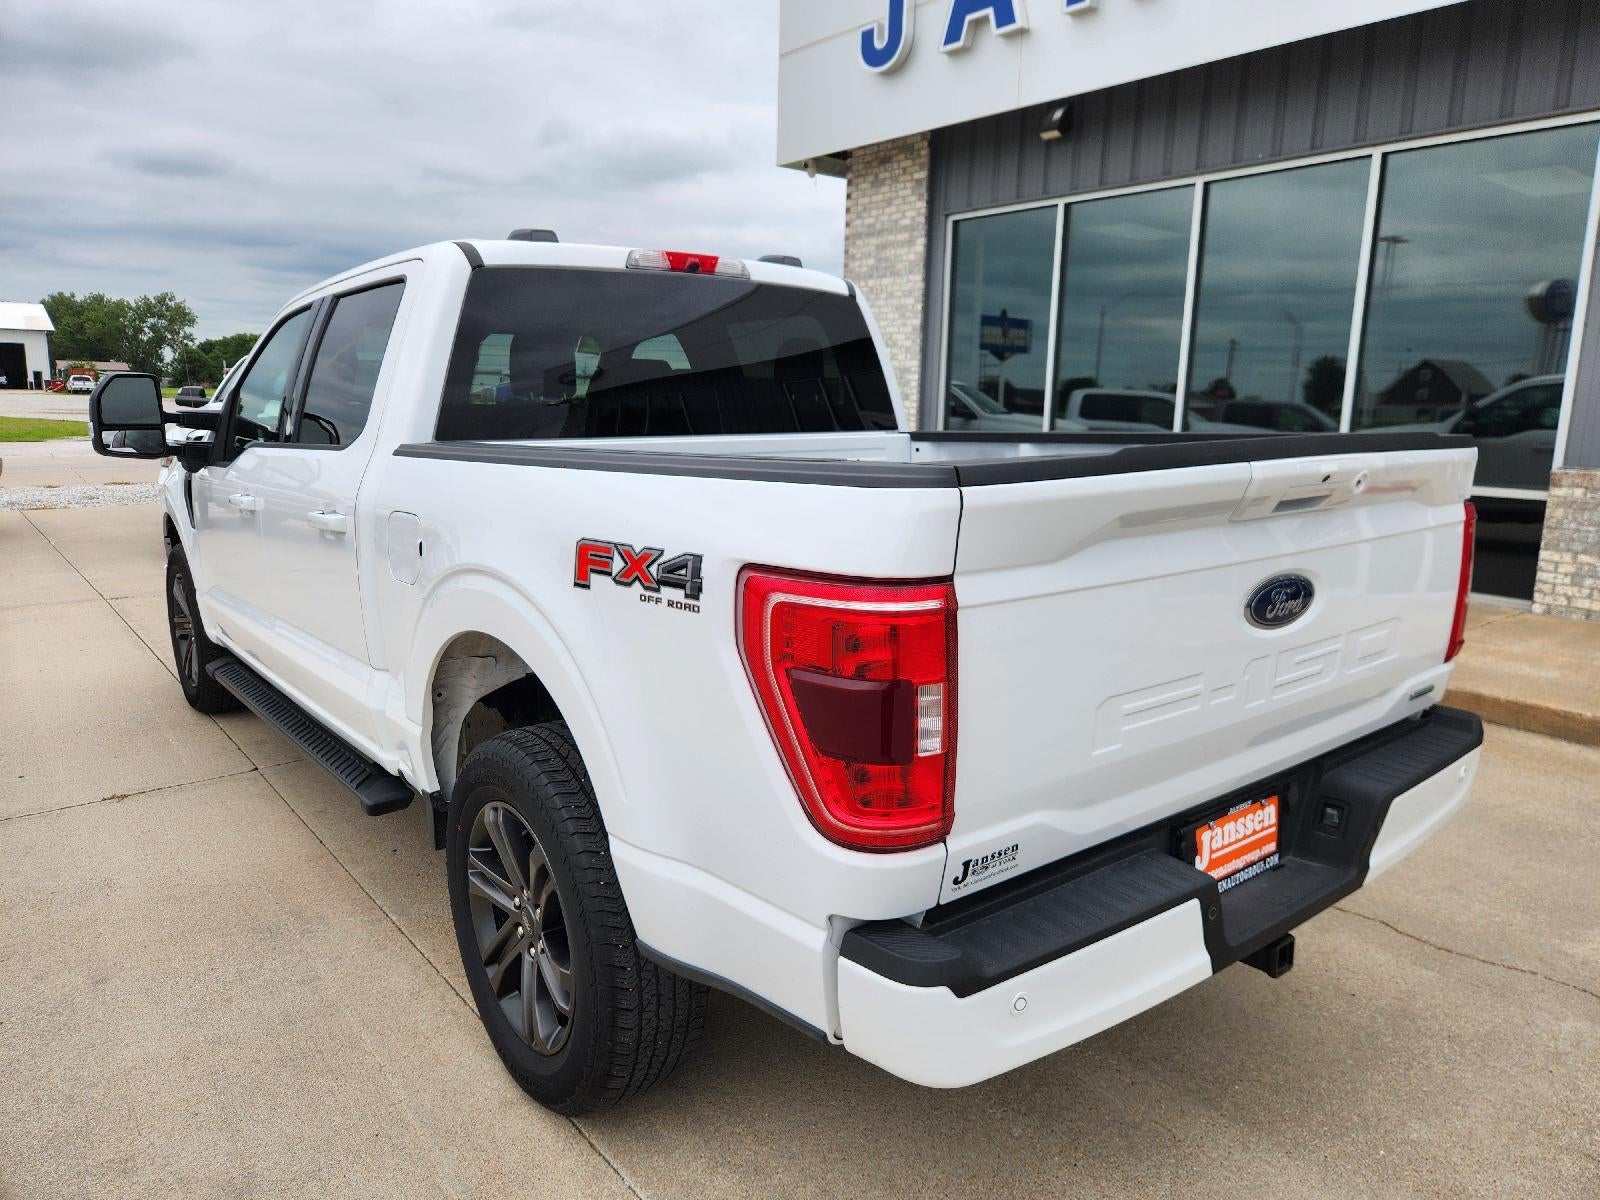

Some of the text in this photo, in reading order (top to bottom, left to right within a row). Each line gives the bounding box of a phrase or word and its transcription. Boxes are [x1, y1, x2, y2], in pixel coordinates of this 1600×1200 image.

[573, 537, 703, 601] FX4
[639, 593, 700, 613] OFF ROAD
[1265, 586, 1304, 619] Ford
[1092, 616, 1404, 755] F-150
[953, 843, 1019, 885] Janssen
[1195, 804, 1277, 872] Janssen
